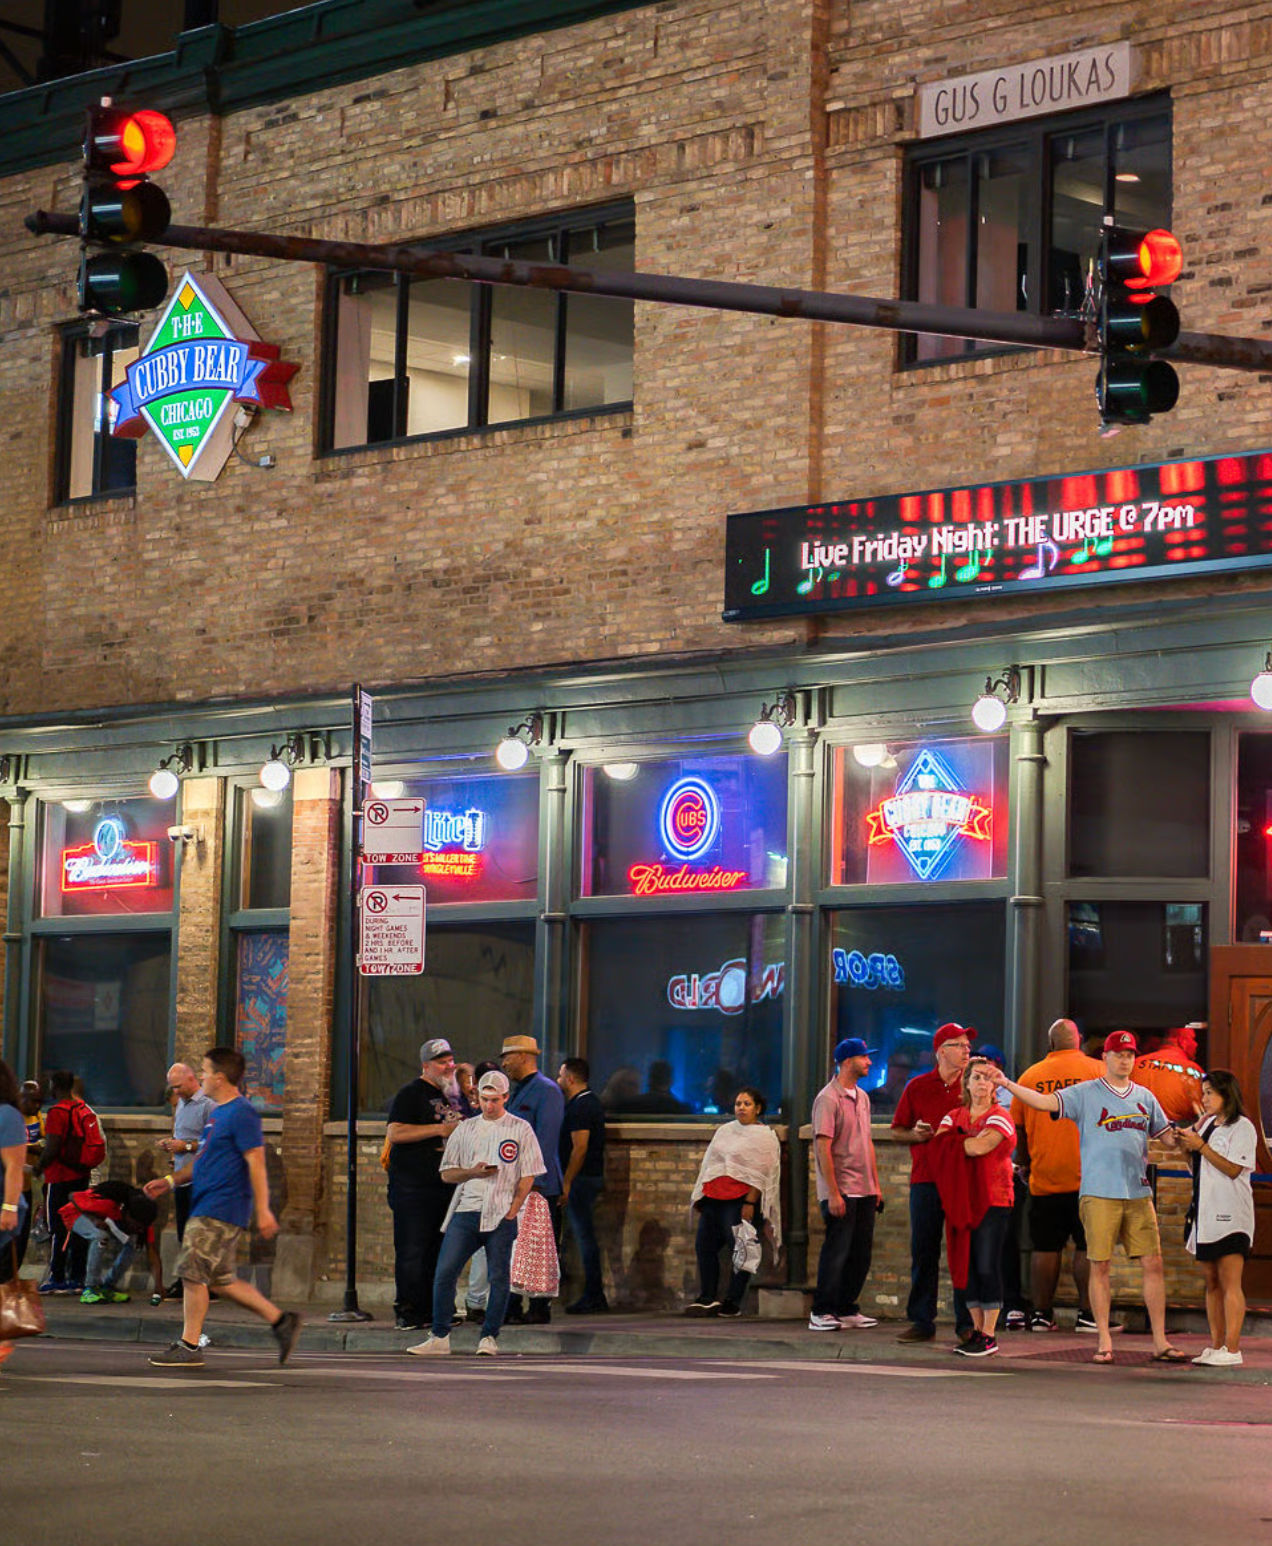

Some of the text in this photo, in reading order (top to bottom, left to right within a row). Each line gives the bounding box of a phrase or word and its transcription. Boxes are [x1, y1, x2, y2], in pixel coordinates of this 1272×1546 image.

[935, 52, 1116, 126] GUS G LOUKAS
[135, 345, 240, 399] CUBBY BEAR
[161, 397, 213, 426] CHICAGO
[801, 501, 1194, 570] Live Friday Night: THE URGE @ 7pm
[366, 853, 419, 862] TOW ZONE
[630, 864, 746, 894] Budweiser
[394, 964, 418, 973] ZONE
